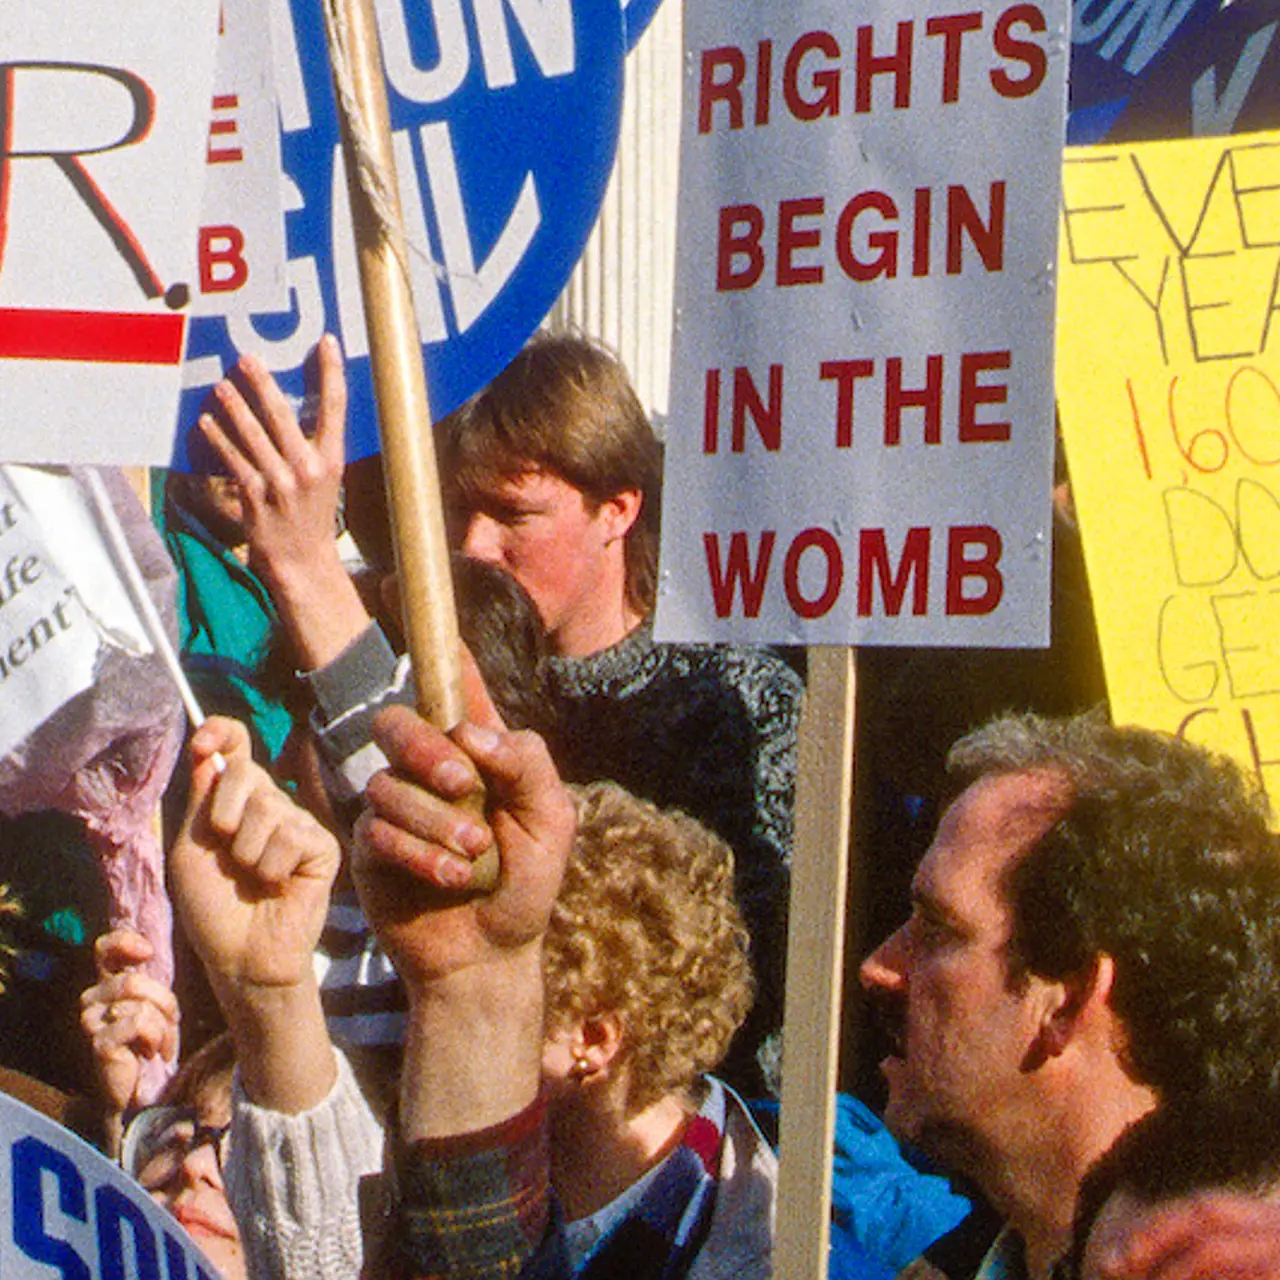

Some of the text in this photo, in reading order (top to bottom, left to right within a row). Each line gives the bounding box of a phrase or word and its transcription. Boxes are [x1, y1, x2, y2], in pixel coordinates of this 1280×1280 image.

[696, 2, 1048, 137] RIGHTS
[715, 179, 1006, 293] BEGIN
[703, 349, 1013, 456] IN THE
[703, 524, 1006, 620] WOMB
